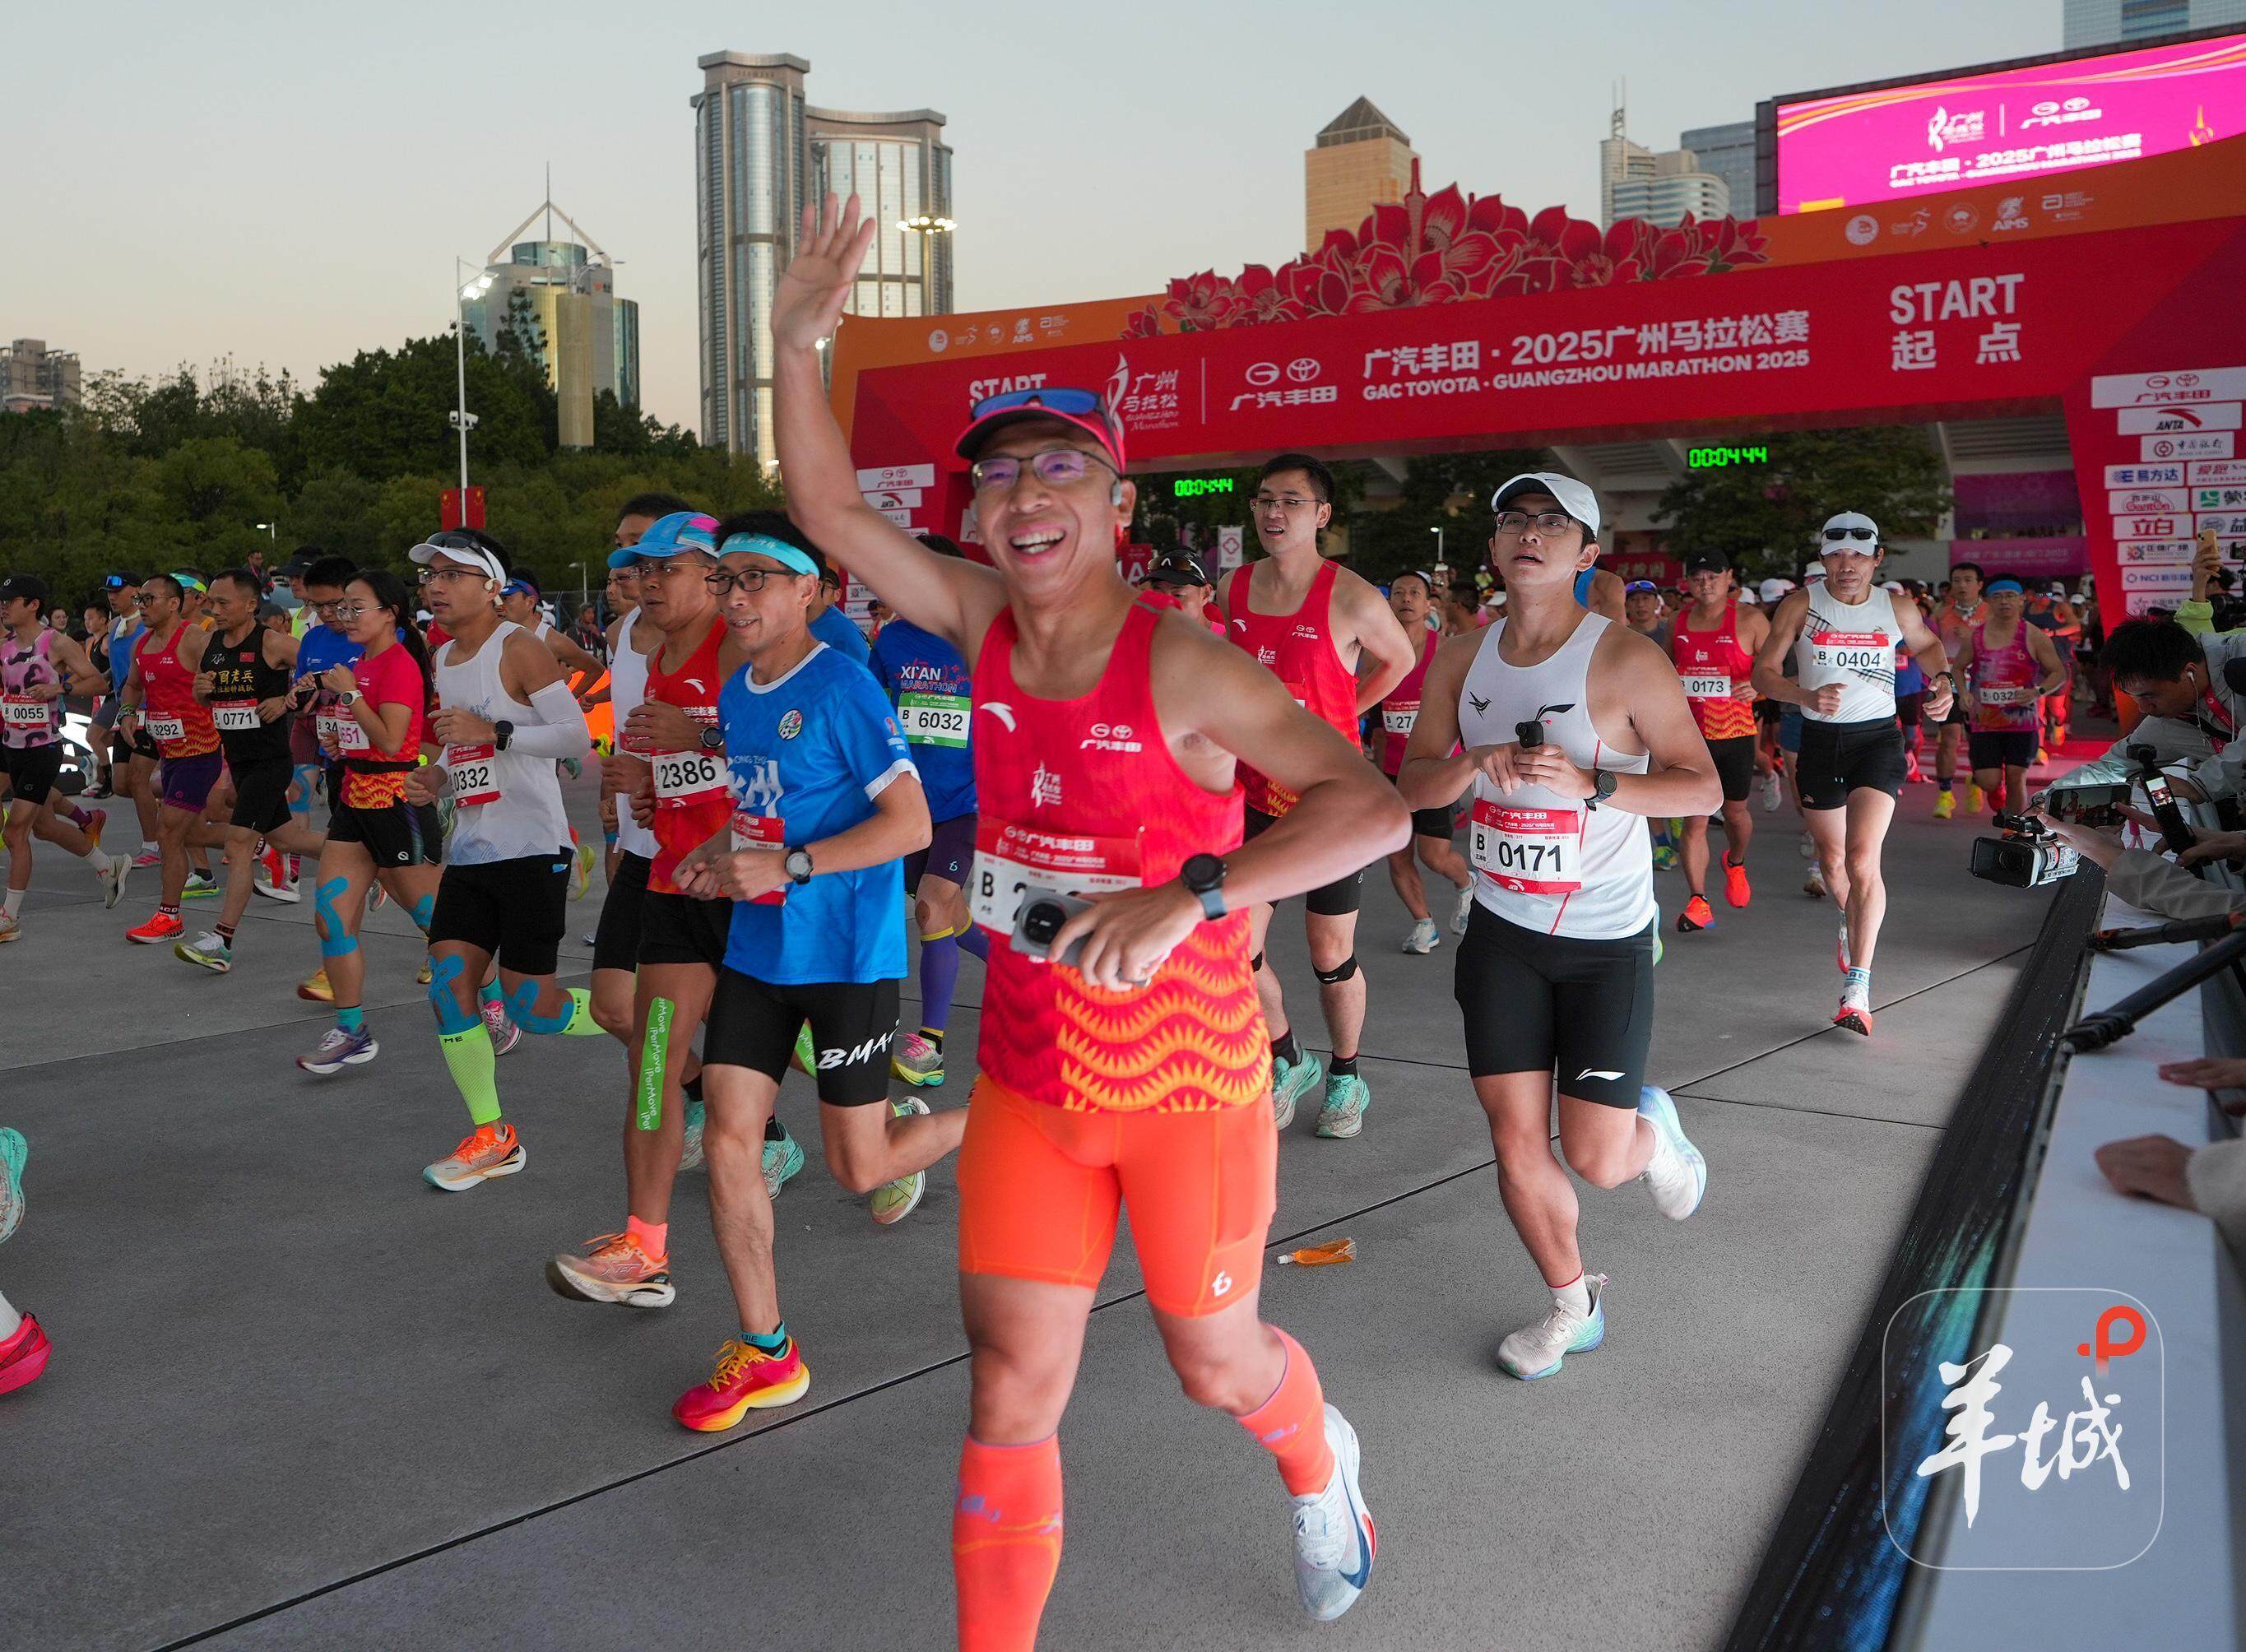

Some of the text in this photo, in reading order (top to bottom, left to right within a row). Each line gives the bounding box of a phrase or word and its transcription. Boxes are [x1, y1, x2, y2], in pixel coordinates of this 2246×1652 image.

[1990, 216, 2030, 232] AIMS
[1890, 273, 2025, 325] START
[1132, 369, 1179, 394] 广州
[1362, 384, 1403, 401] GAC
[1404, 376, 1480, 397] TOYOTA
[1492, 367, 1622, 391] GUANGZHOU
[1626, 354, 1752, 379] MARATHON
[1756, 349, 1810, 369] 2025
[1122, 393, 1178, 412] 马拉松
[1228, 385, 1337, 411] 广汽丰田
[2135, 389, 2211, 403] 广汽丰田
[2156, 420, 2184, 431] ANTA
[2137, 467, 2179, 482] 易方达
[2132, 518, 2174, 536] 立白
[1818, 651, 1881, 667] B 0404
[900, 680, 958, 693] MARATHON
[1692, 680, 1724, 693] 0173
[14, 708, 44, 719] 0055
[223, 712, 253, 726] 0771
[903, 709, 963, 731] B 6032
[154, 724, 179, 736] 3292
[1396, 716, 1412, 729] 27
[453, 766, 490, 792] 0332
[660, 757, 716, 789] 2386
[1501, 811, 1547, 819] 广汽丰田
[1477, 833, 1562, 872] B 0171
[981, 870, 994, 897] B
